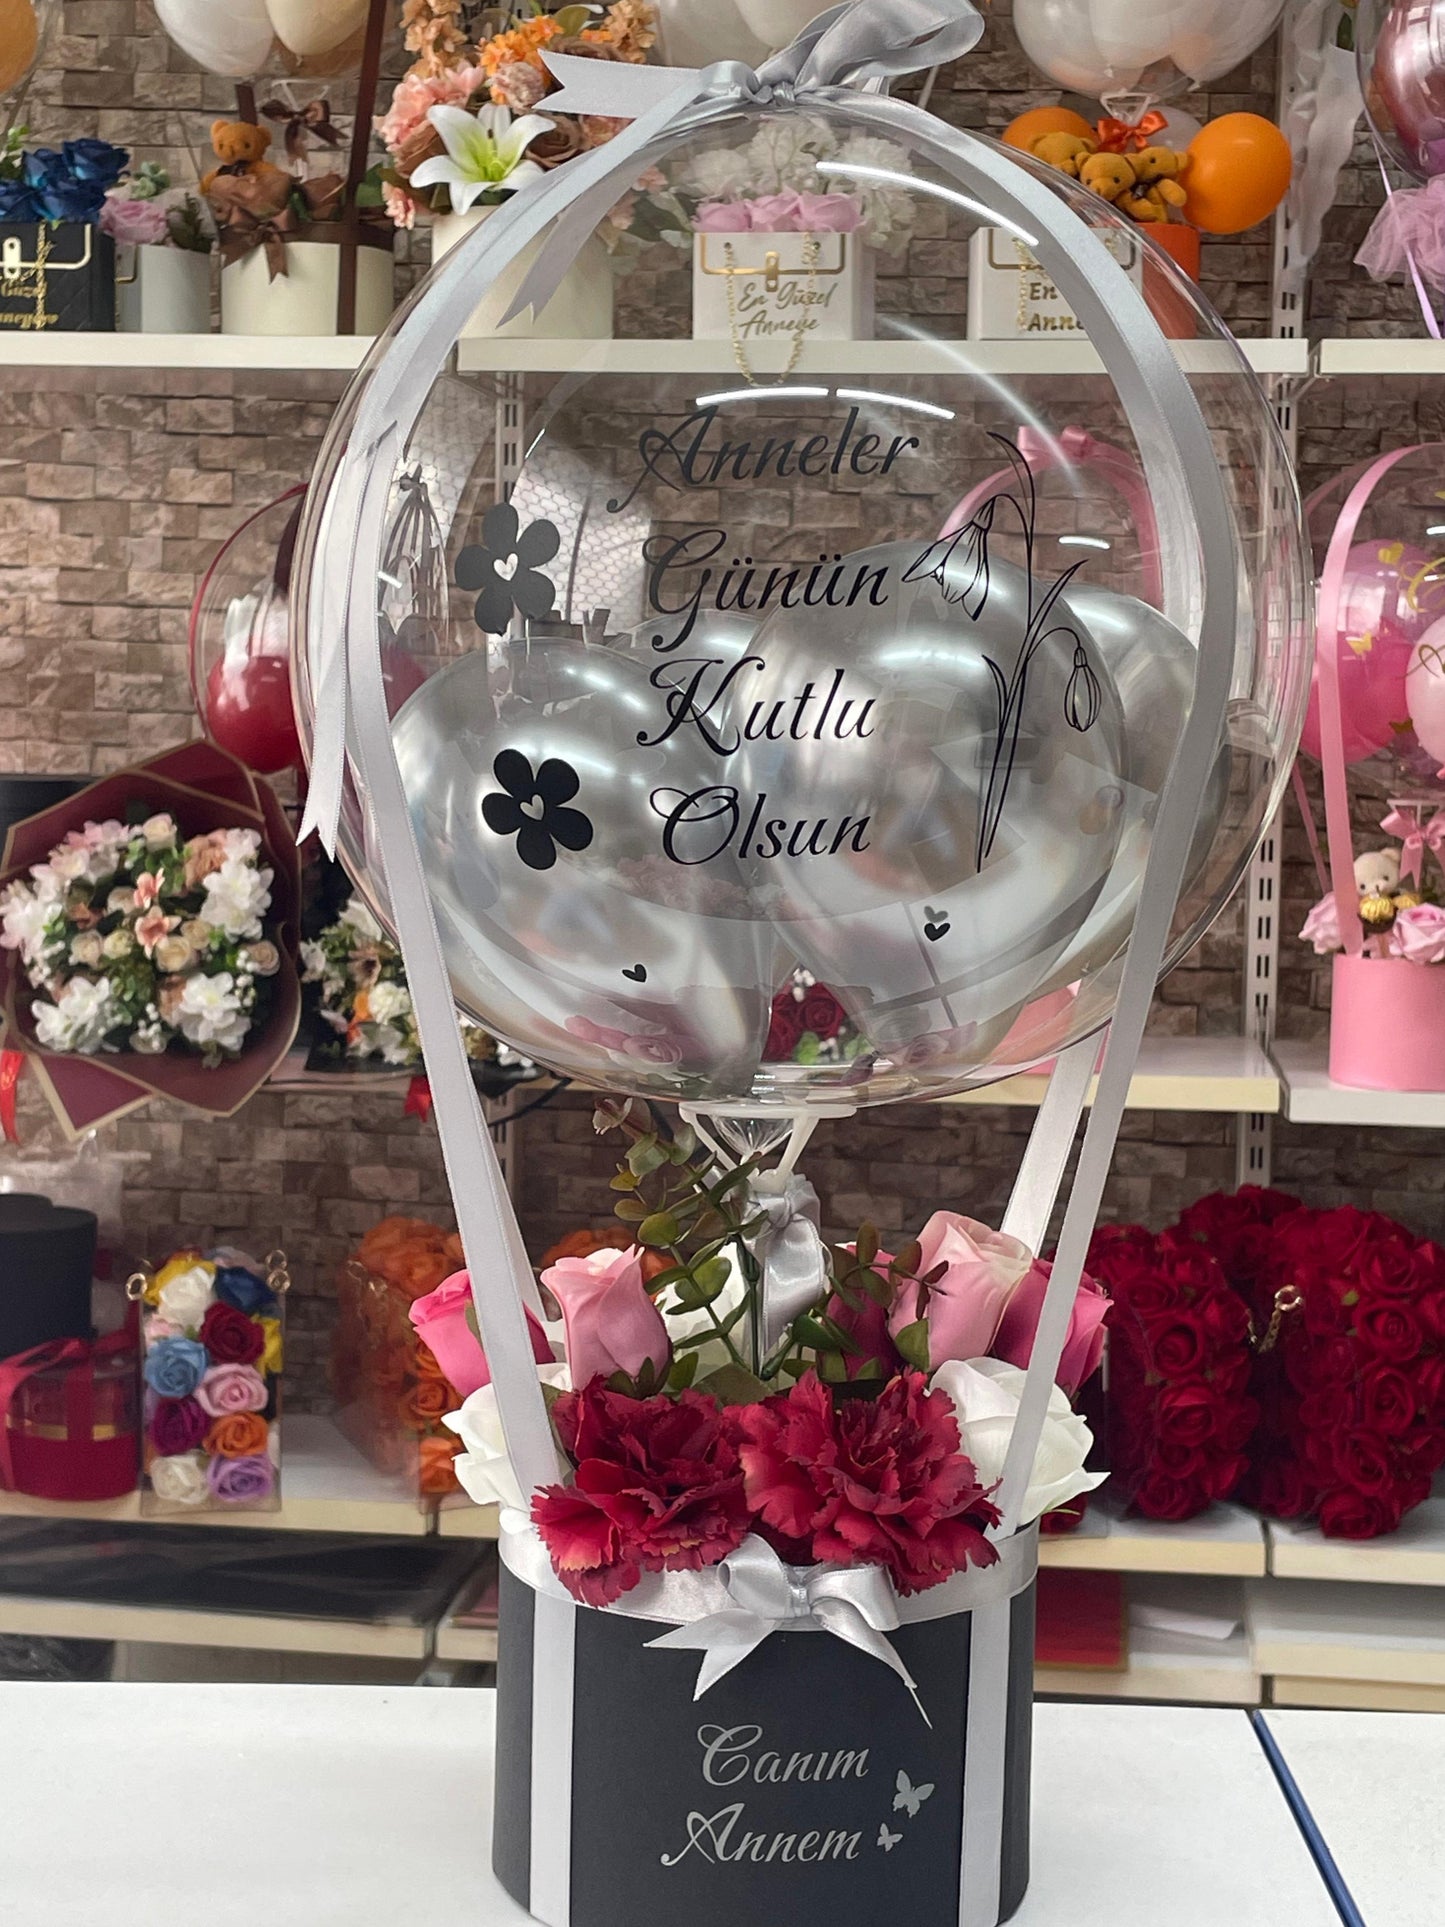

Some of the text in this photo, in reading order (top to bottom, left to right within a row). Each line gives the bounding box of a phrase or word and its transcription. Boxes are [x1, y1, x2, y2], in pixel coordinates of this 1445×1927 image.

[738, 283, 768, 311] En
[1029, 282, 1058, 301] En
[607, 406, 919, 513] Anneler
[642, 529, 890, 652] Günün
[637, 656, 876, 756] Kutlu
[649, 785, 872, 866] Olsun
[697, 1724, 869, 1786] Canım
[660, 1802, 862, 1866] Annem
